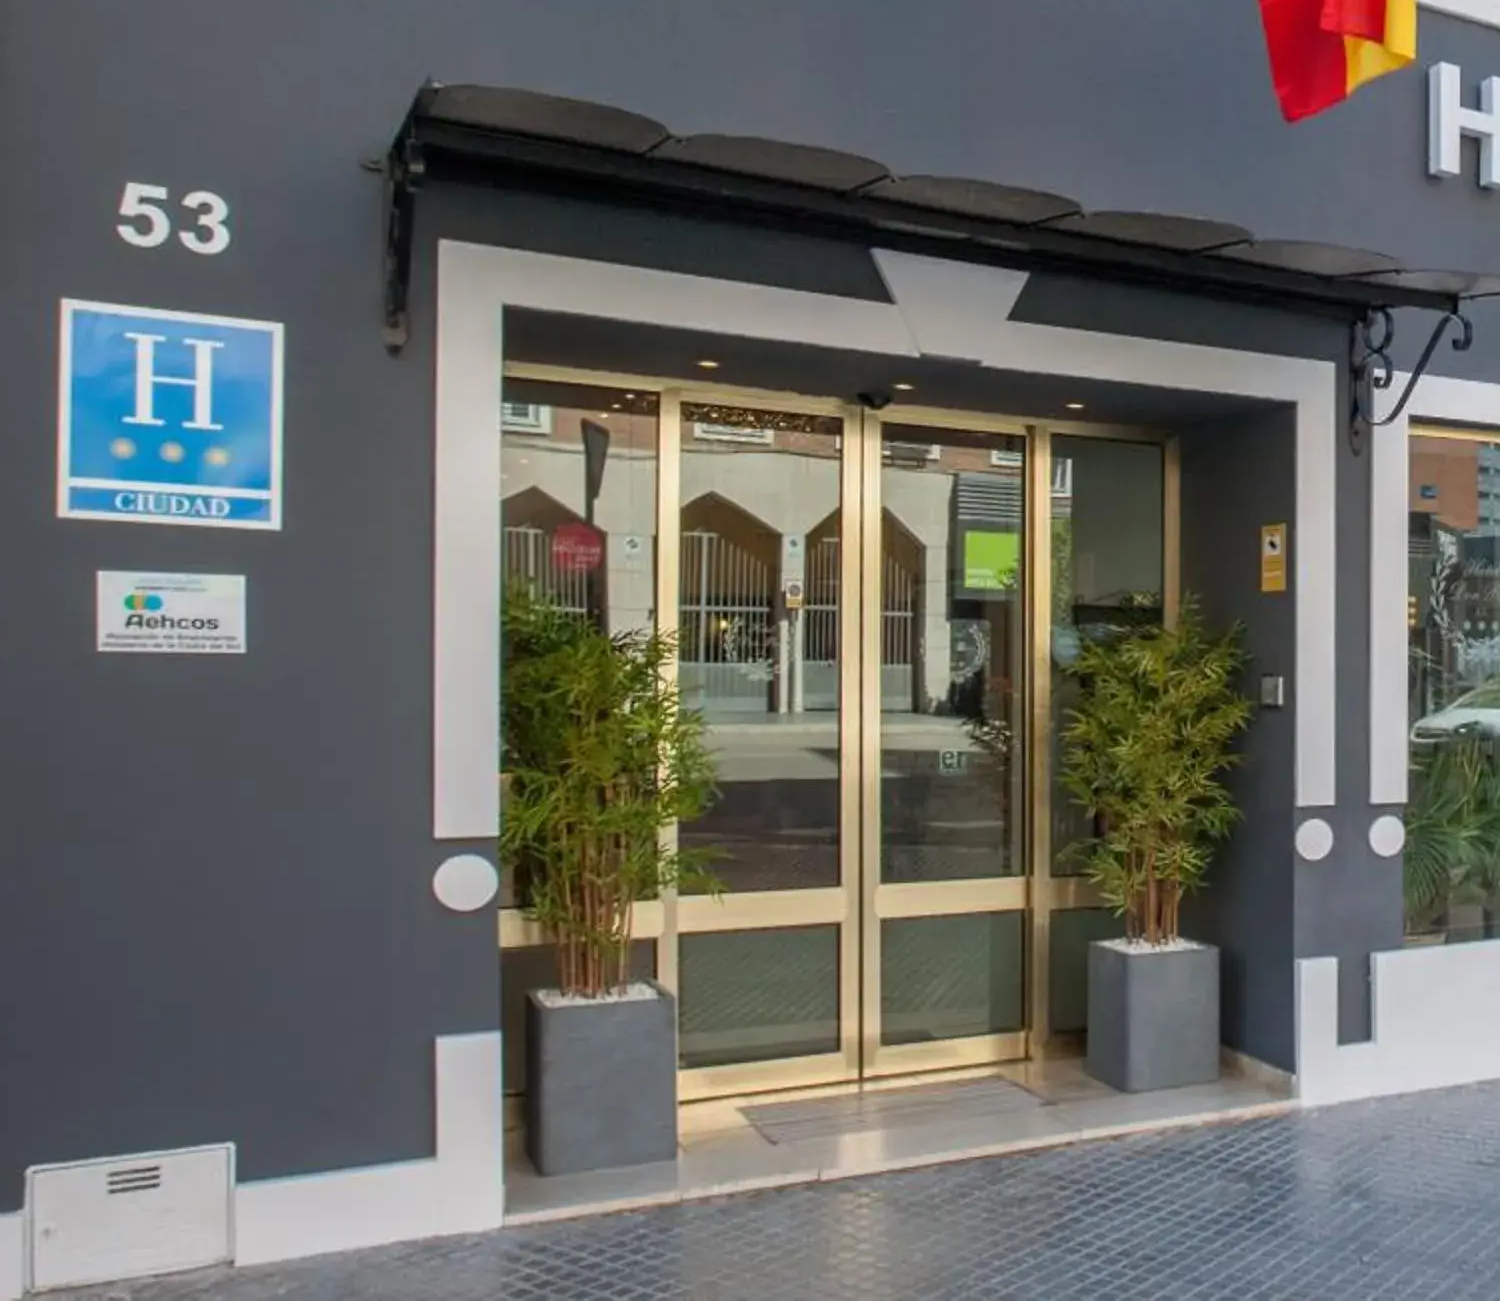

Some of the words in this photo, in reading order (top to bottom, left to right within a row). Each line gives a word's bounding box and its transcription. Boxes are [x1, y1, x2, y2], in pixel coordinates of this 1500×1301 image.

[115, 181, 232, 255] 53
[122, 331, 225, 431] H
[114, 491, 232, 518] CIUDAD
[124, 613, 220, 630] Aehcos
